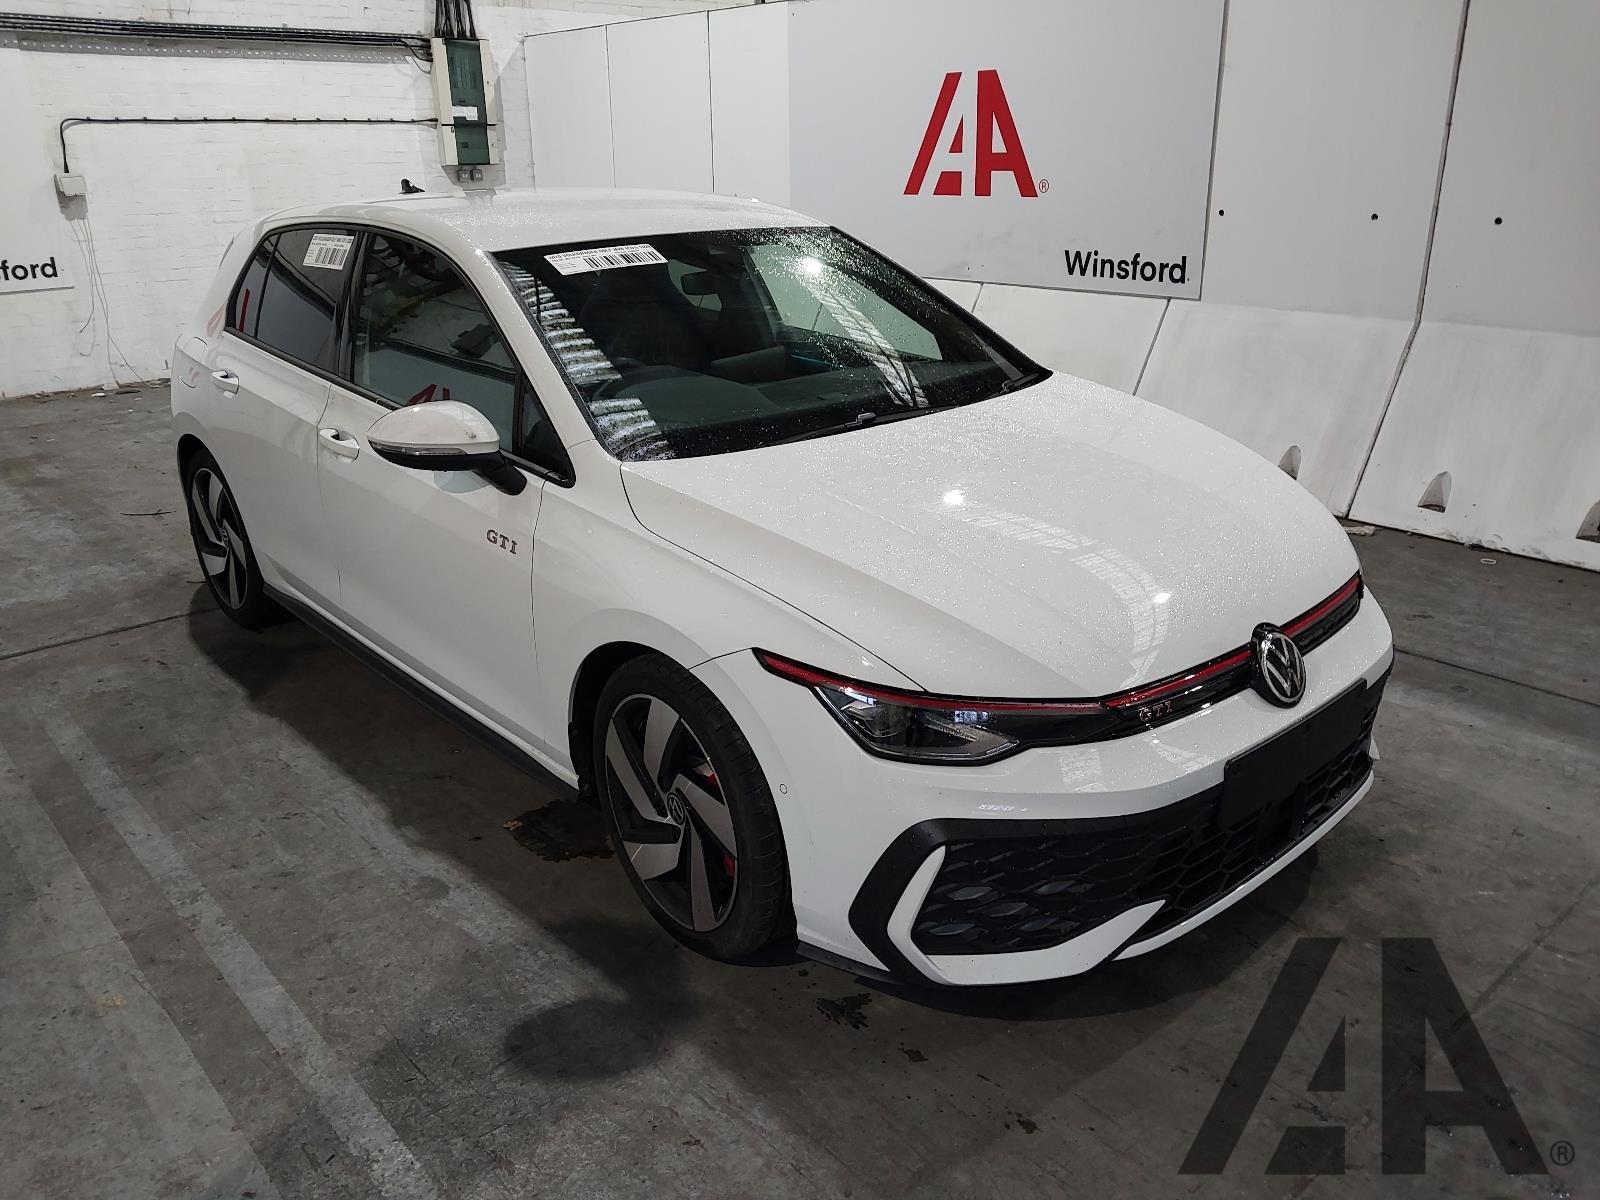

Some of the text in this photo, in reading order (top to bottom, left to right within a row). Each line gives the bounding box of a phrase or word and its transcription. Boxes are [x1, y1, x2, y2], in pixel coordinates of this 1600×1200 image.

[0, 256, 58, 281] ford
[1064, 249, 1187, 284] Winsford
[486, 529, 518, 555] GTI
[1138, 700, 1173, 721] GTI
